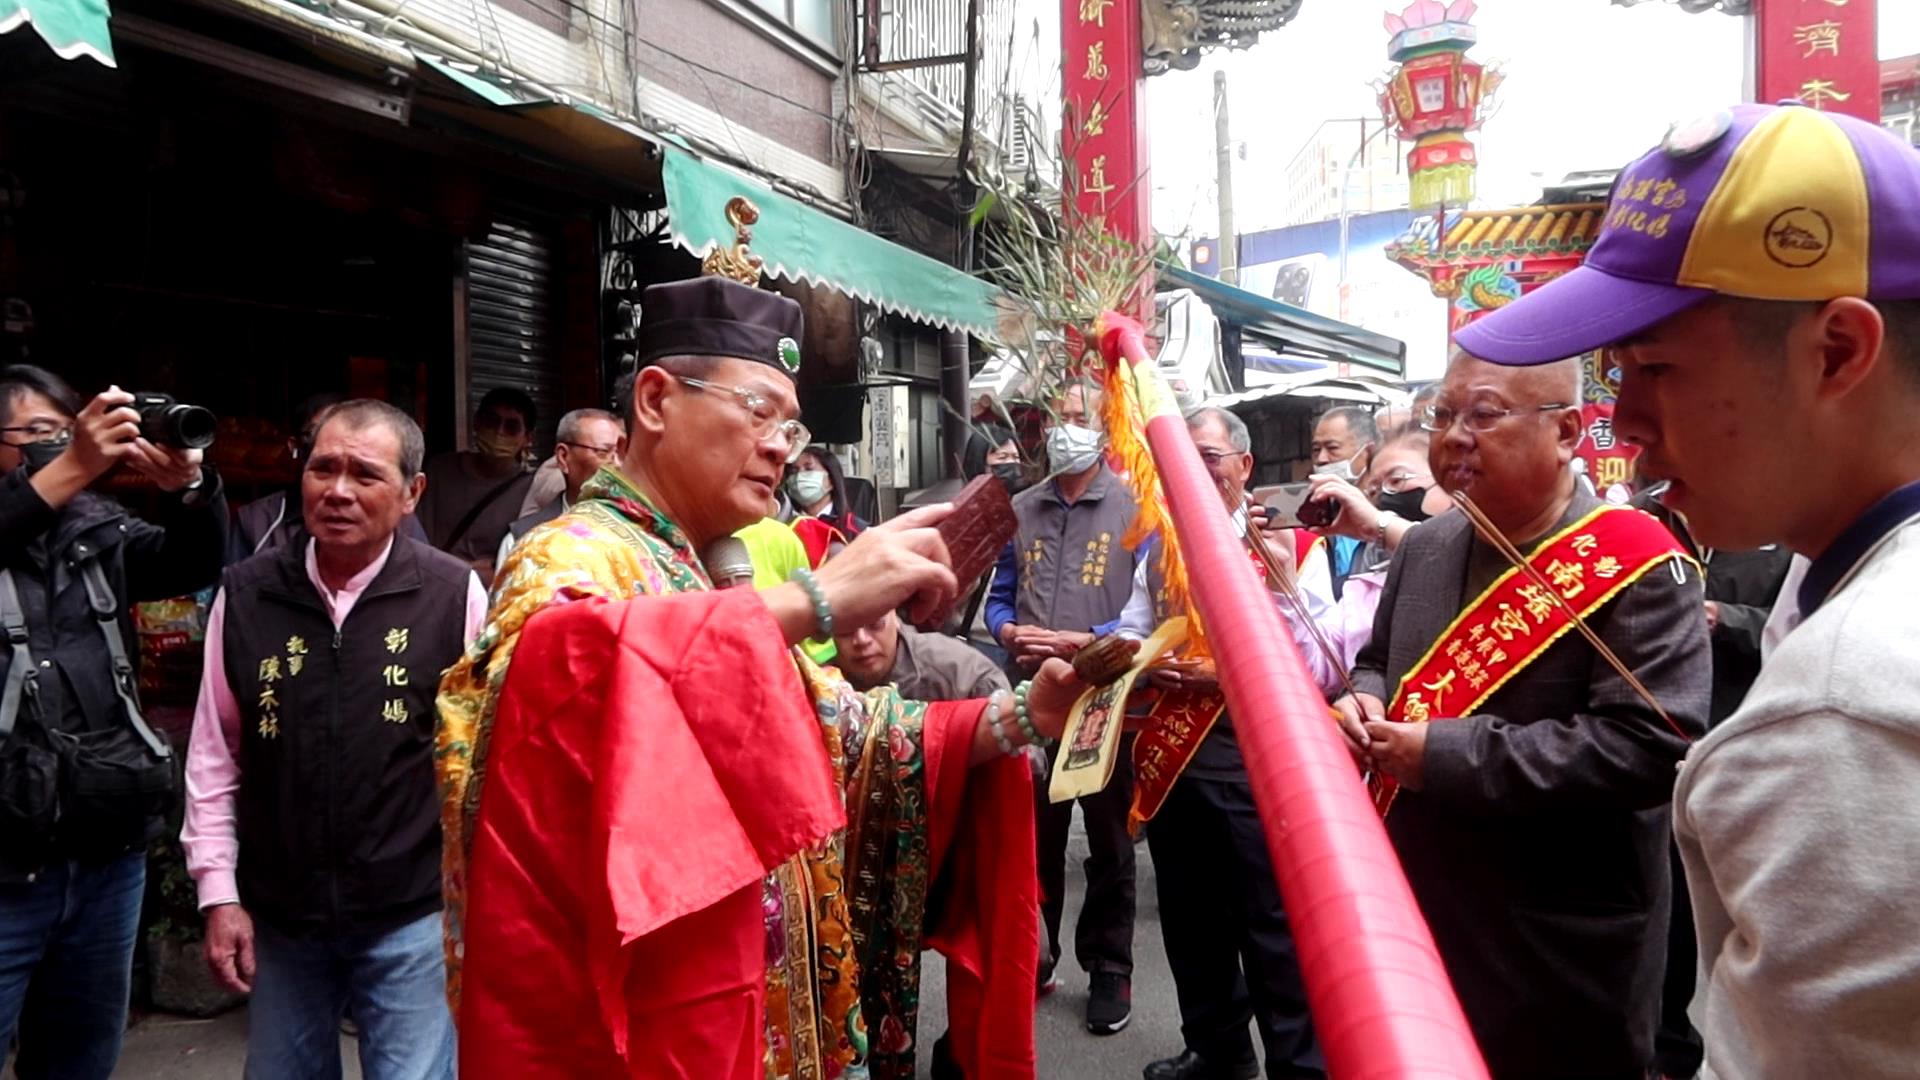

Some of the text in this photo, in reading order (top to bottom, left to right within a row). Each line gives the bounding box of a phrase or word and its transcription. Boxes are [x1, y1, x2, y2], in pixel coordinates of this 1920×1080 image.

[1793, 0, 1851, 110] 濟本
[1571, 533, 1623, 579] 彰化
[381, 627, 410, 725] 彰化媽
